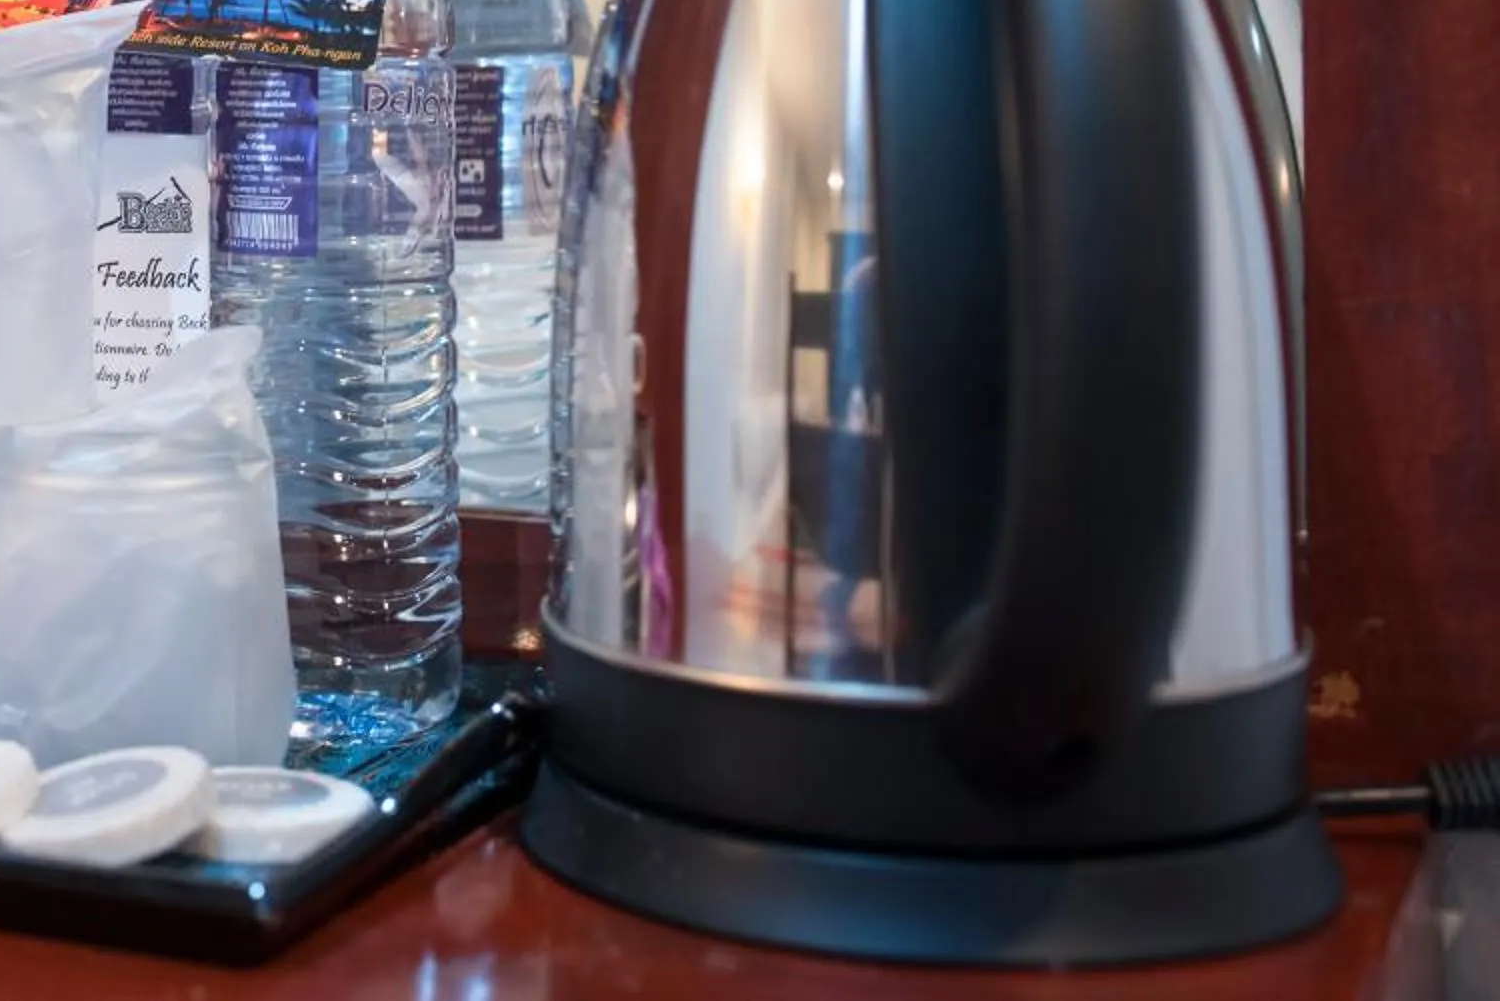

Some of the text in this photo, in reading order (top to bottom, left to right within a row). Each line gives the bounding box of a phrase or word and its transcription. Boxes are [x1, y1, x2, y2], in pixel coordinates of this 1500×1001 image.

[190, 35, 236, 51] Resort
[260, 41, 290, 55] Koh
[97, 256, 202, 292] Feedback
[103, 310, 123, 333] for
[178, 312, 208, 331] Beck
[95, 365, 121, 390] ding
